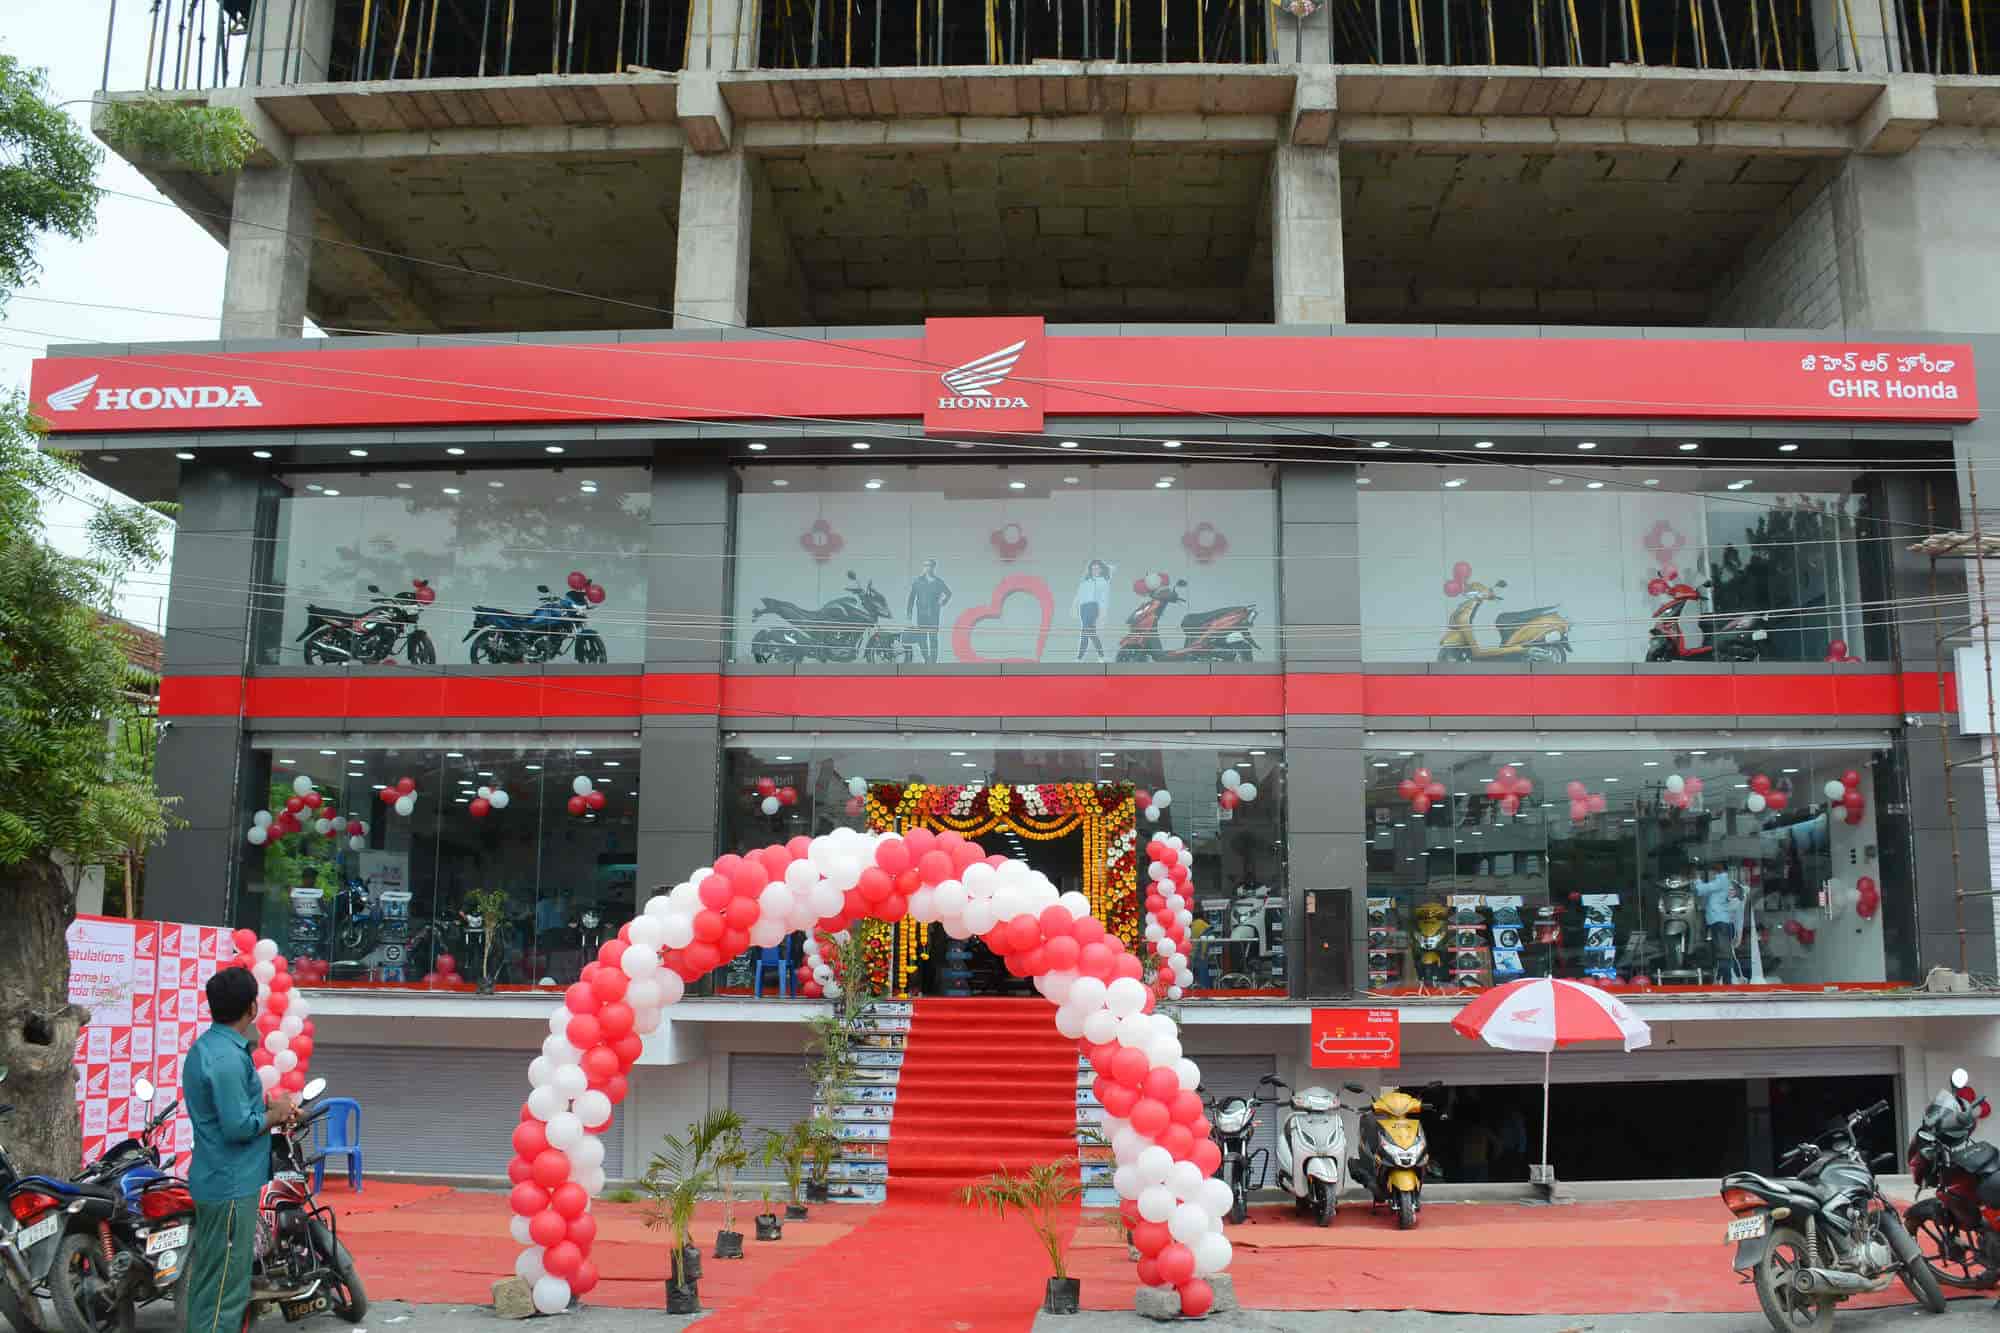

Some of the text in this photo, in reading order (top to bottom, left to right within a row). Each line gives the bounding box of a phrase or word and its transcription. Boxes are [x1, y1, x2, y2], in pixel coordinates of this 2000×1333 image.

[94, 385, 263, 411] HONDA
[1828, 379, 1958, 399] GHR Honda
[938, 396, 1030, 409] HONDA
